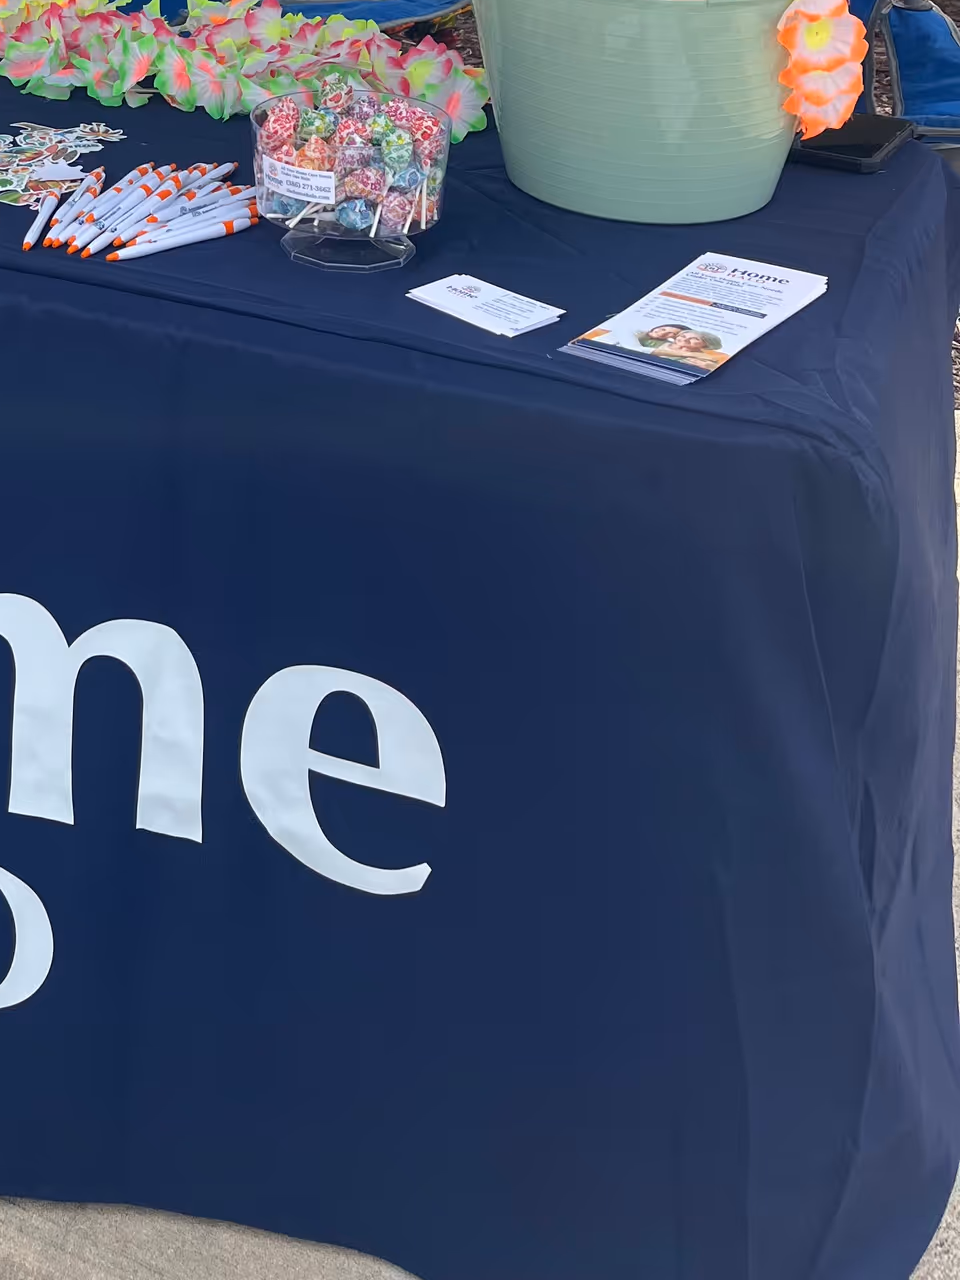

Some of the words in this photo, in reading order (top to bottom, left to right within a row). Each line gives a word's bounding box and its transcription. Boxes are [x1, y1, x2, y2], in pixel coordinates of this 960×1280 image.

[265, 173, 284, 186] Home
[727, 273, 766, 284] HALO
[730, 268, 790, 285] Home
[446, 285, 478, 298] Home
